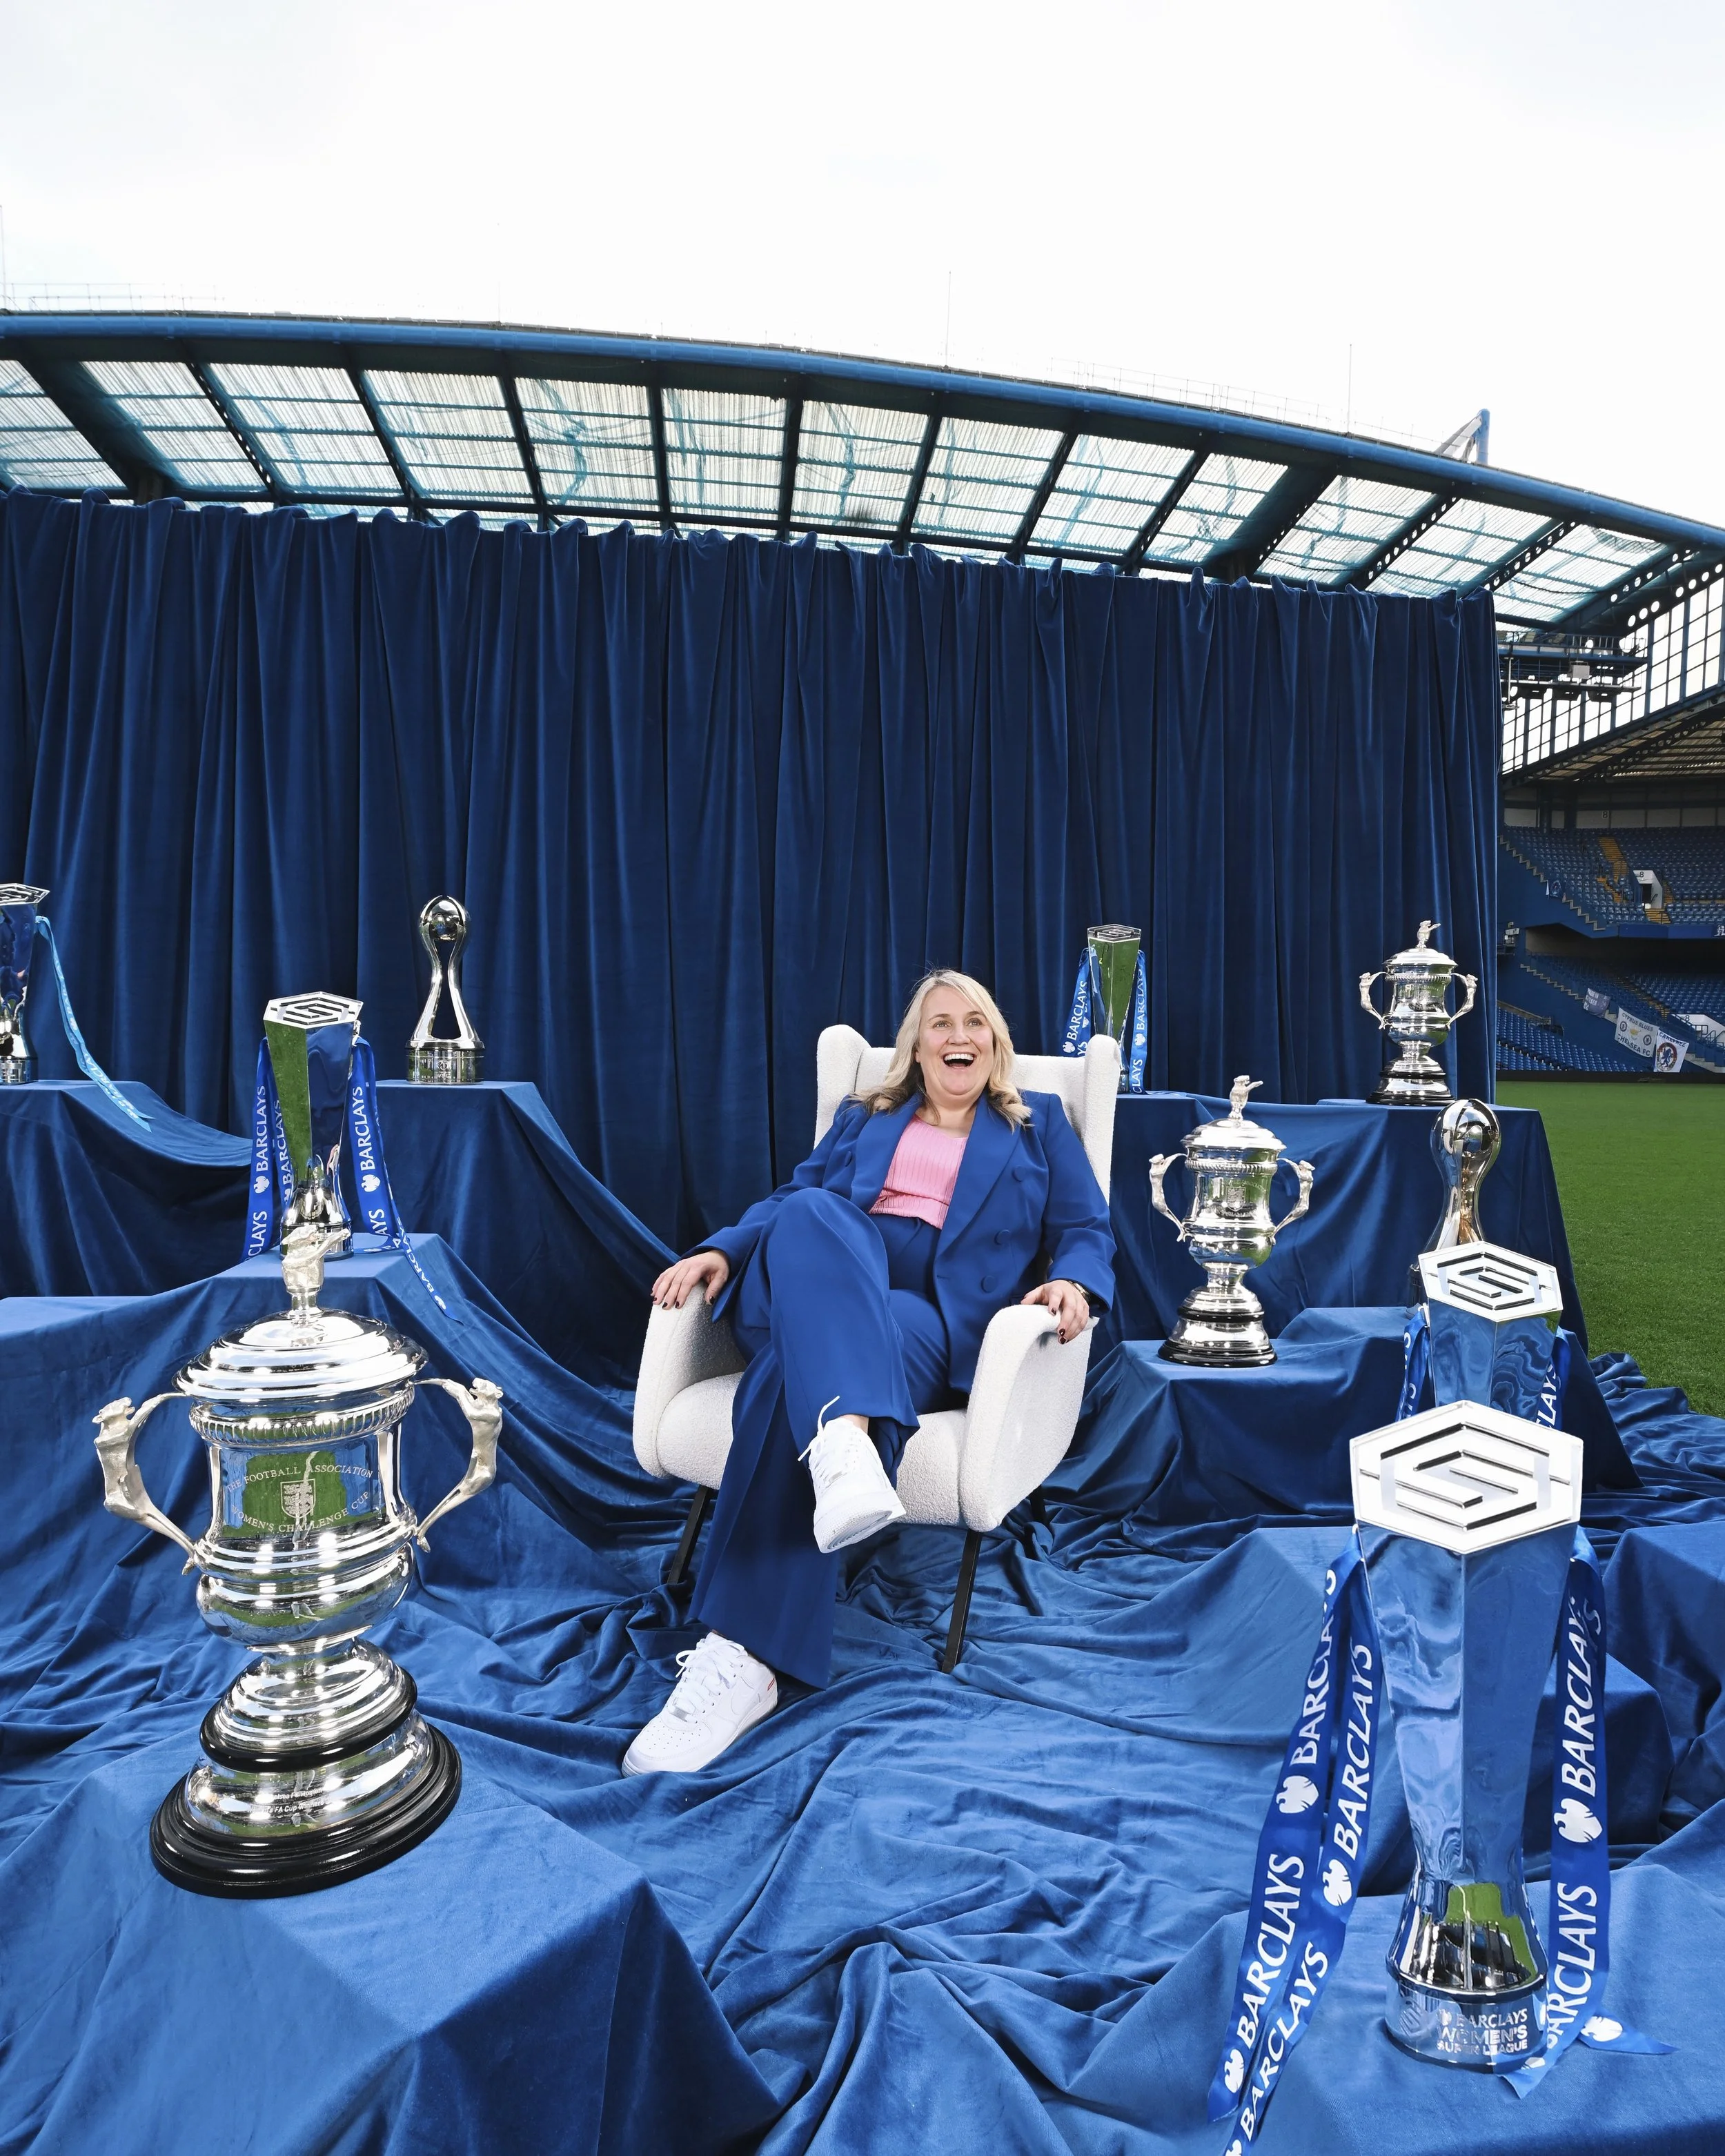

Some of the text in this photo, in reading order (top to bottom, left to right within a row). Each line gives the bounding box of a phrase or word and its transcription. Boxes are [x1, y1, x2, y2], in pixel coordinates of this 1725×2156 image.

[1602, 811, 1608, 819] 8
[1066, 980, 1088, 1040] BARCLAYS
[1136, 969, 1146, 1031] BARCLAYS
[1621, 1012, 1653, 1032] CYPRUS BLUES
[1642, 1047, 1650, 1056] FC
[1659, 1031, 1687, 1048] CAREFREE
[1132, 1058, 1143, 1094] CLAYS
[256, 1085, 268, 1172] BARCLAYS
[274, 1099, 293, 1185] BARCLAYS
[352, 1086, 376, 1171] BARCLAYS
[245, 1210, 268, 1261] CLAYS
[397, 1216, 435, 1293] BARCLAYS
[226, 1465, 373, 1492] THE FOOTBALL ASSOCIATION
[231, 1491, 369, 1532] WOMEN'S CHALLENGE CUP
[1289, 1569, 1337, 1767] BARCLA
[1561, 1596, 1597, 1797] BARCLAY
[1332, 1638, 1373, 1861] BARCLAYS
[299, 1799, 324, 1810] Winners
[1236, 1853, 1305, 2048] BARCLAYS
[1240, 1941, 1329, 2142] BARCLAYS
[1437, 2024, 1528, 2045] WOMEN'S
[1456, 2008, 1528, 2029] BARCLAYS
